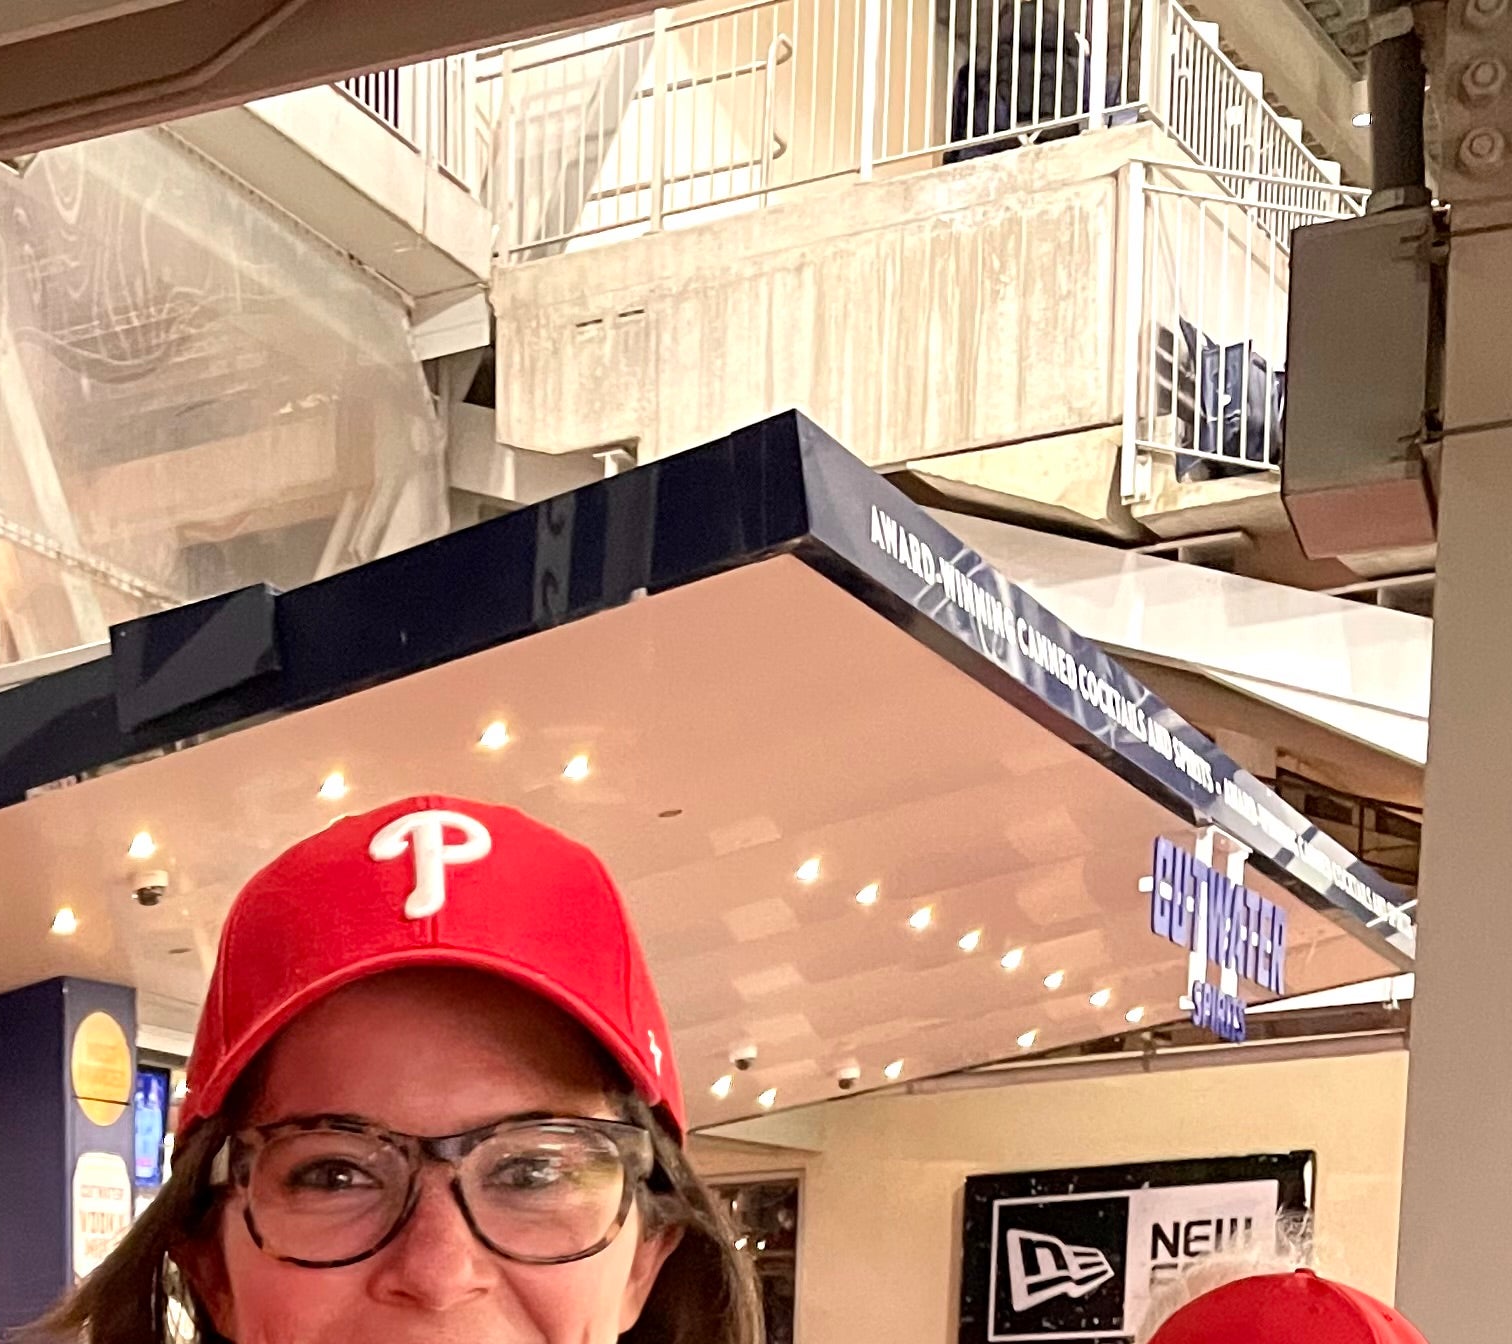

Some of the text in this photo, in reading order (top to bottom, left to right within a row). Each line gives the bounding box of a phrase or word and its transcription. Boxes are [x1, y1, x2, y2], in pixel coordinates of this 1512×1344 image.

[871, 505, 1016, 645] AWARD-WINNING
[1016, 617, 1077, 690] CANNED
[1078, 663, 1148, 743] COCKTAILS
[368, 809, 492, 920] P
